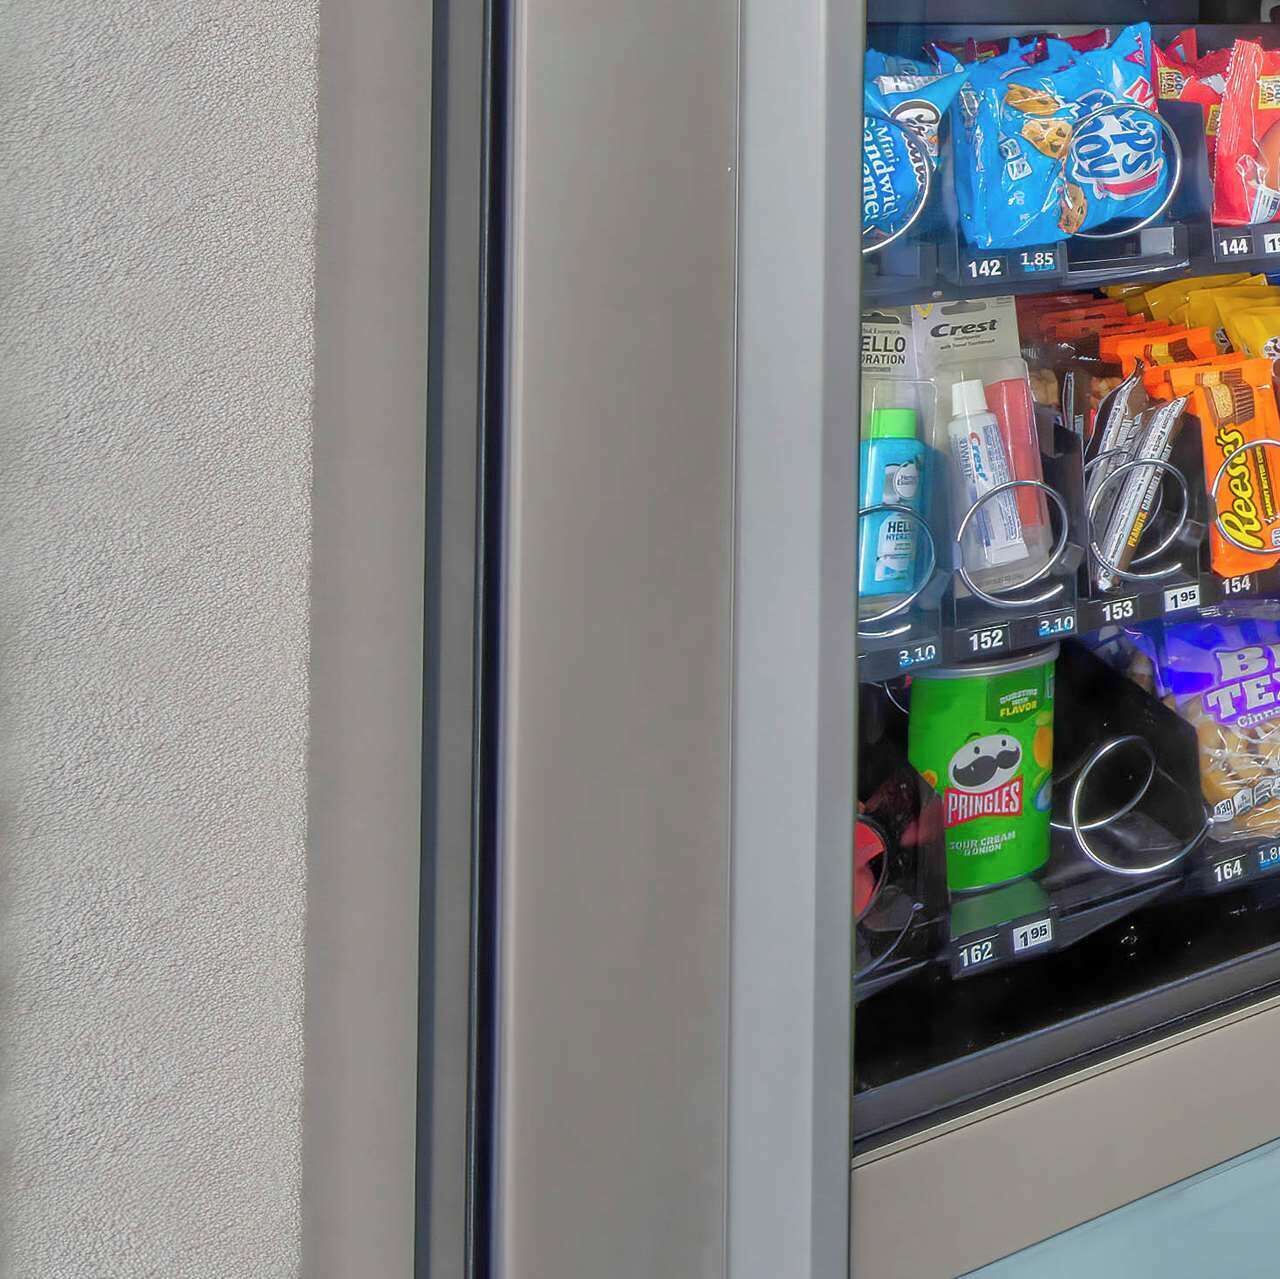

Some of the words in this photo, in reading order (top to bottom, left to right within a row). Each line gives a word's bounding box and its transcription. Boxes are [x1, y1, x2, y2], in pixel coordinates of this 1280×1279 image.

[877, 125, 901, 163] Mini
[1220, 239, 1248, 256] 144
[969, 260, 1002, 278] 142
[1021, 252, 1054, 266] 1.85
[930, 319, 998, 338] Crest
[861, 336, 906, 353] ELLO
[968, 431, 988, 481] Crest
[1219, 424, 1265, 550] Reese's
[1222, 577, 1251, 594] 154
[1102, 602, 1134, 622] 153
[969, 630, 1003, 651] 152
[948, 781, 1021, 824] PRINGLES
[1214, 859, 1242, 881] 164
[959, 942, 993, 968] 162
